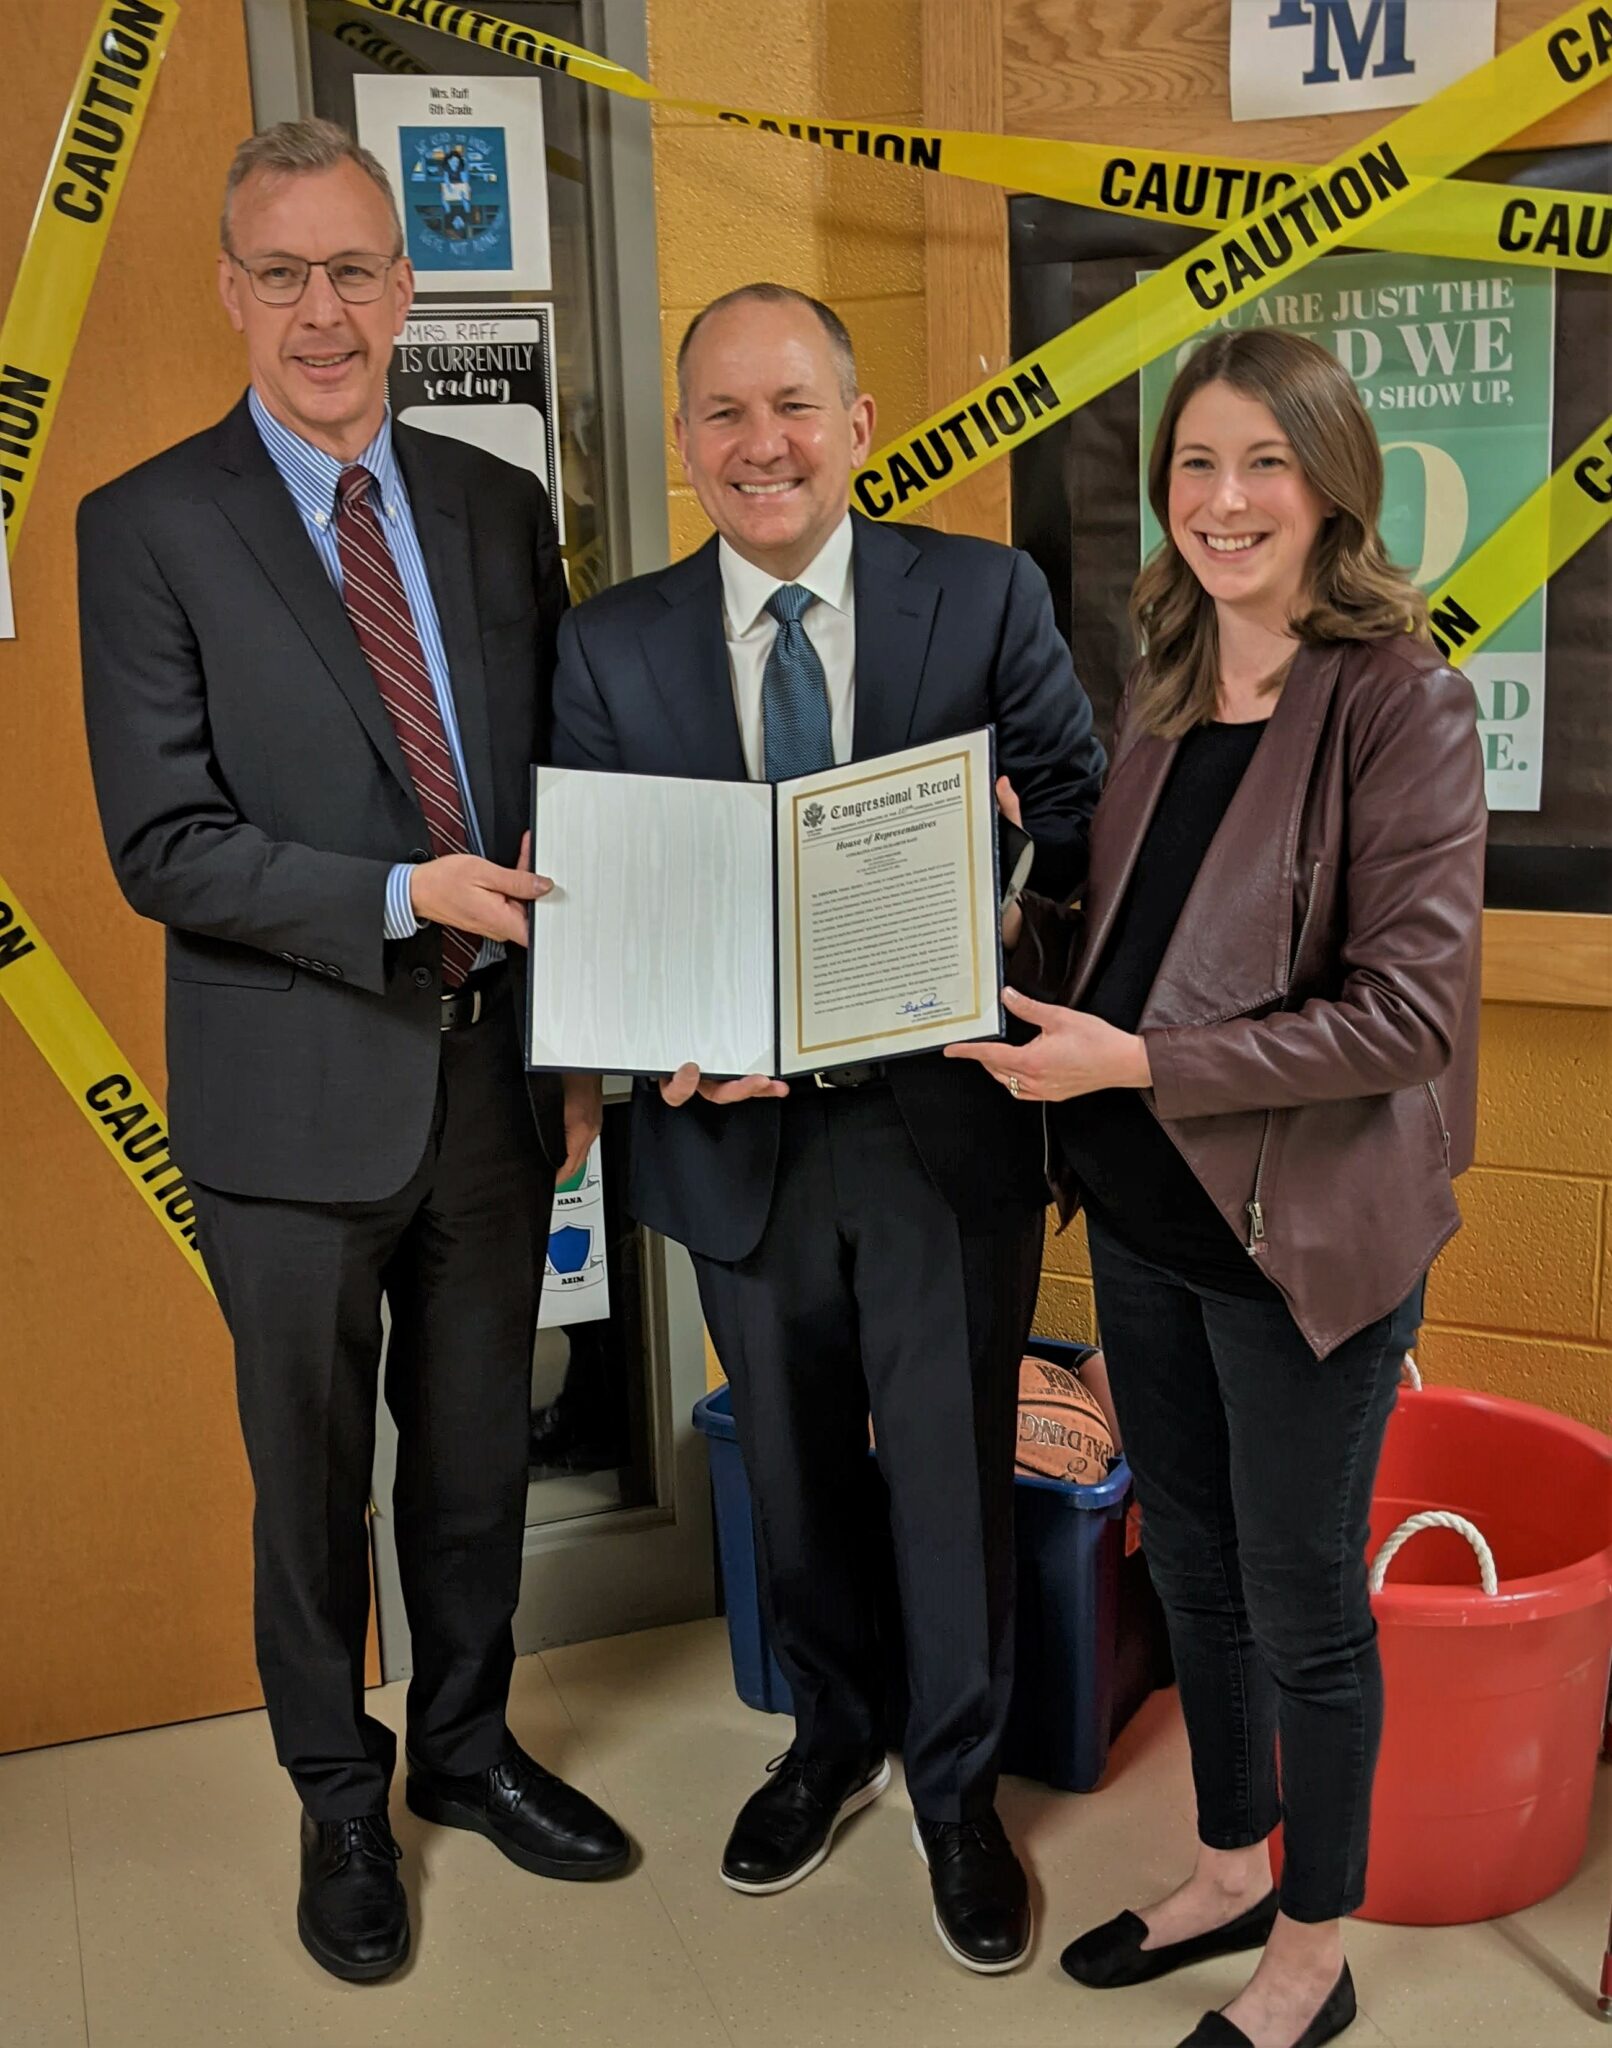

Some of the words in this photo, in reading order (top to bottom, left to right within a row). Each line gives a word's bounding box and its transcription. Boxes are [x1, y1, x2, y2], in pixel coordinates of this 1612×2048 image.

[53, 0, 165, 224] CAUTION
[1185, 141, 1410, 310] CAUTION
[1332, 286, 1425, 321] JUST
[1434, 277, 1515, 313] THE
[456, 322, 501, 341] RAFF
[1397, 317, 1513, 377] WE
[399, 346, 423, 373] IS
[427, 345, 533, 372] CURRENTLY
[423, 371, 510, 404] reading
[1379, 382, 1466, 410] SHOW
[854, 363, 1061, 518] CAUTION
[831, 787, 912, 820] Congressional
[917, 774, 960, 799] Record
[836, 839, 861, 851] House
[874, 820, 937, 842] Representatives
